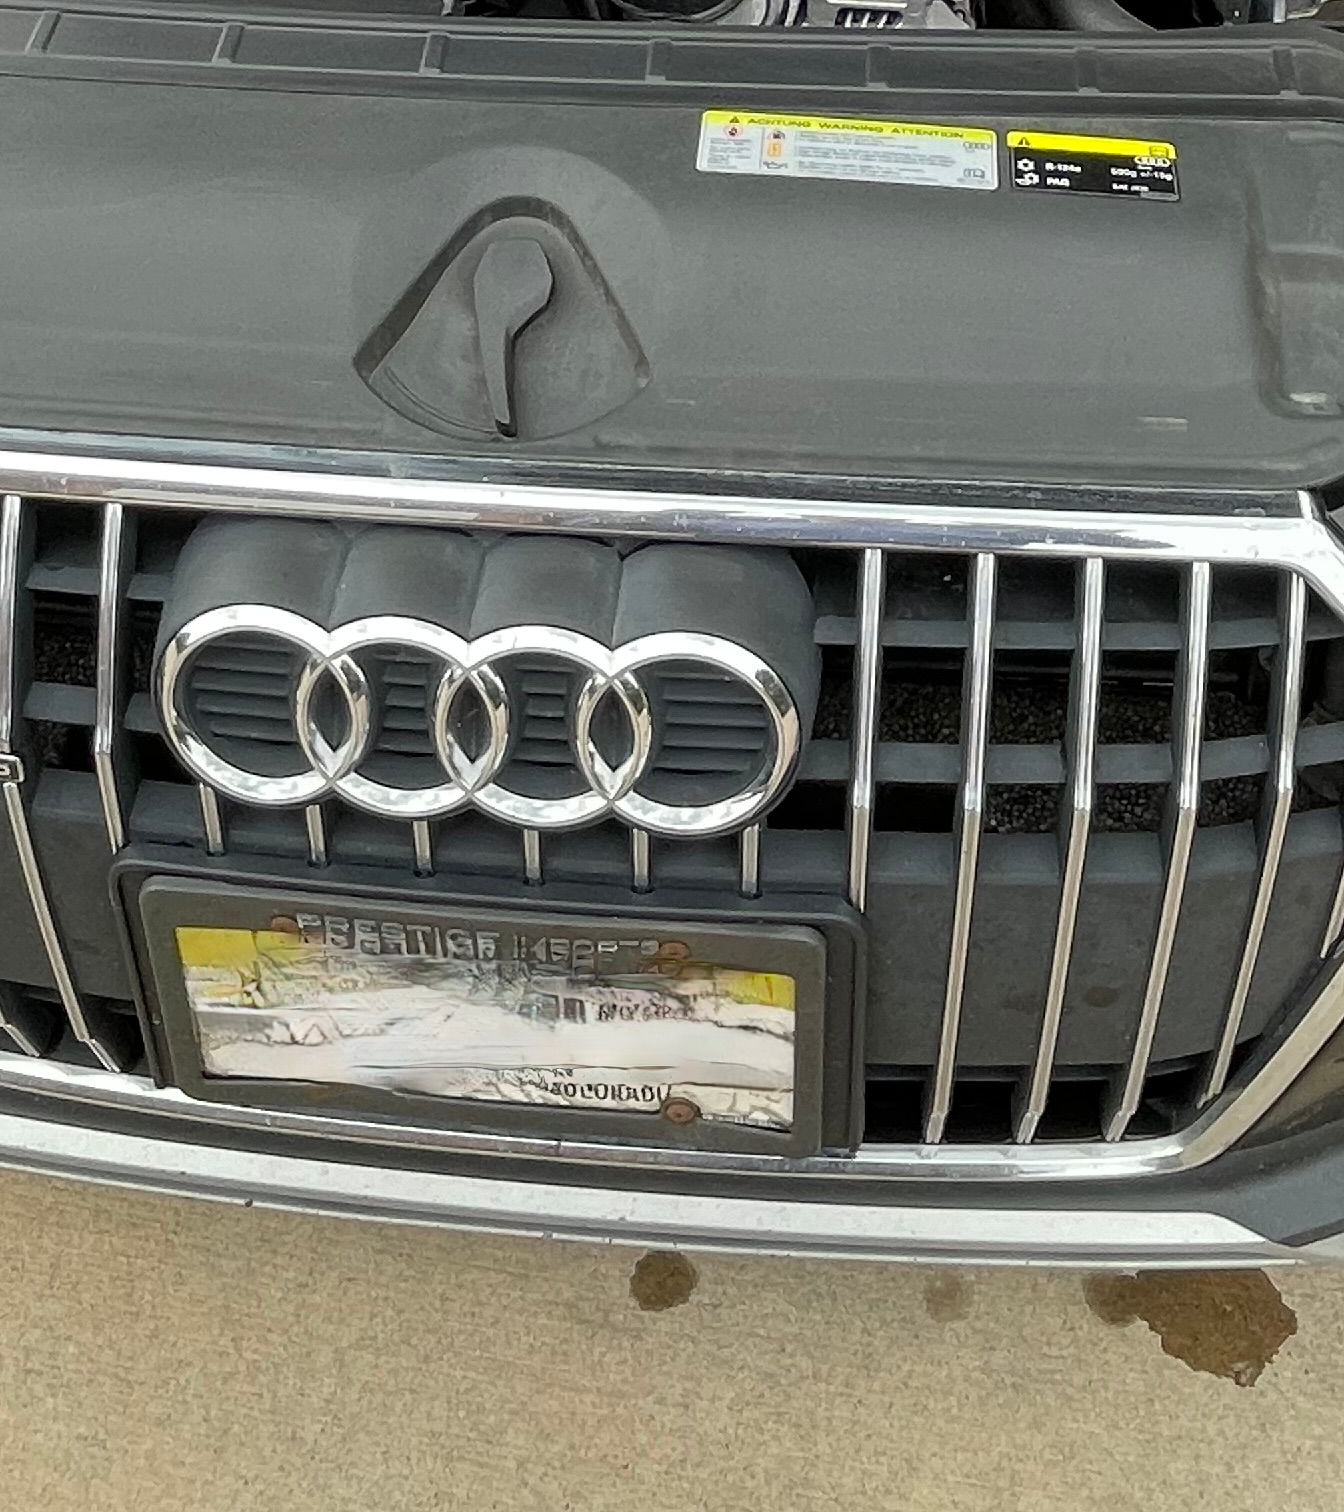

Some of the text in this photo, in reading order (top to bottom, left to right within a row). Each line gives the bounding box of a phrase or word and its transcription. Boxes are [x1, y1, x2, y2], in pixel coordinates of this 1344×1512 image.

[746, 118, 964, 138] ACHTUNG WARNING ATTENTION
